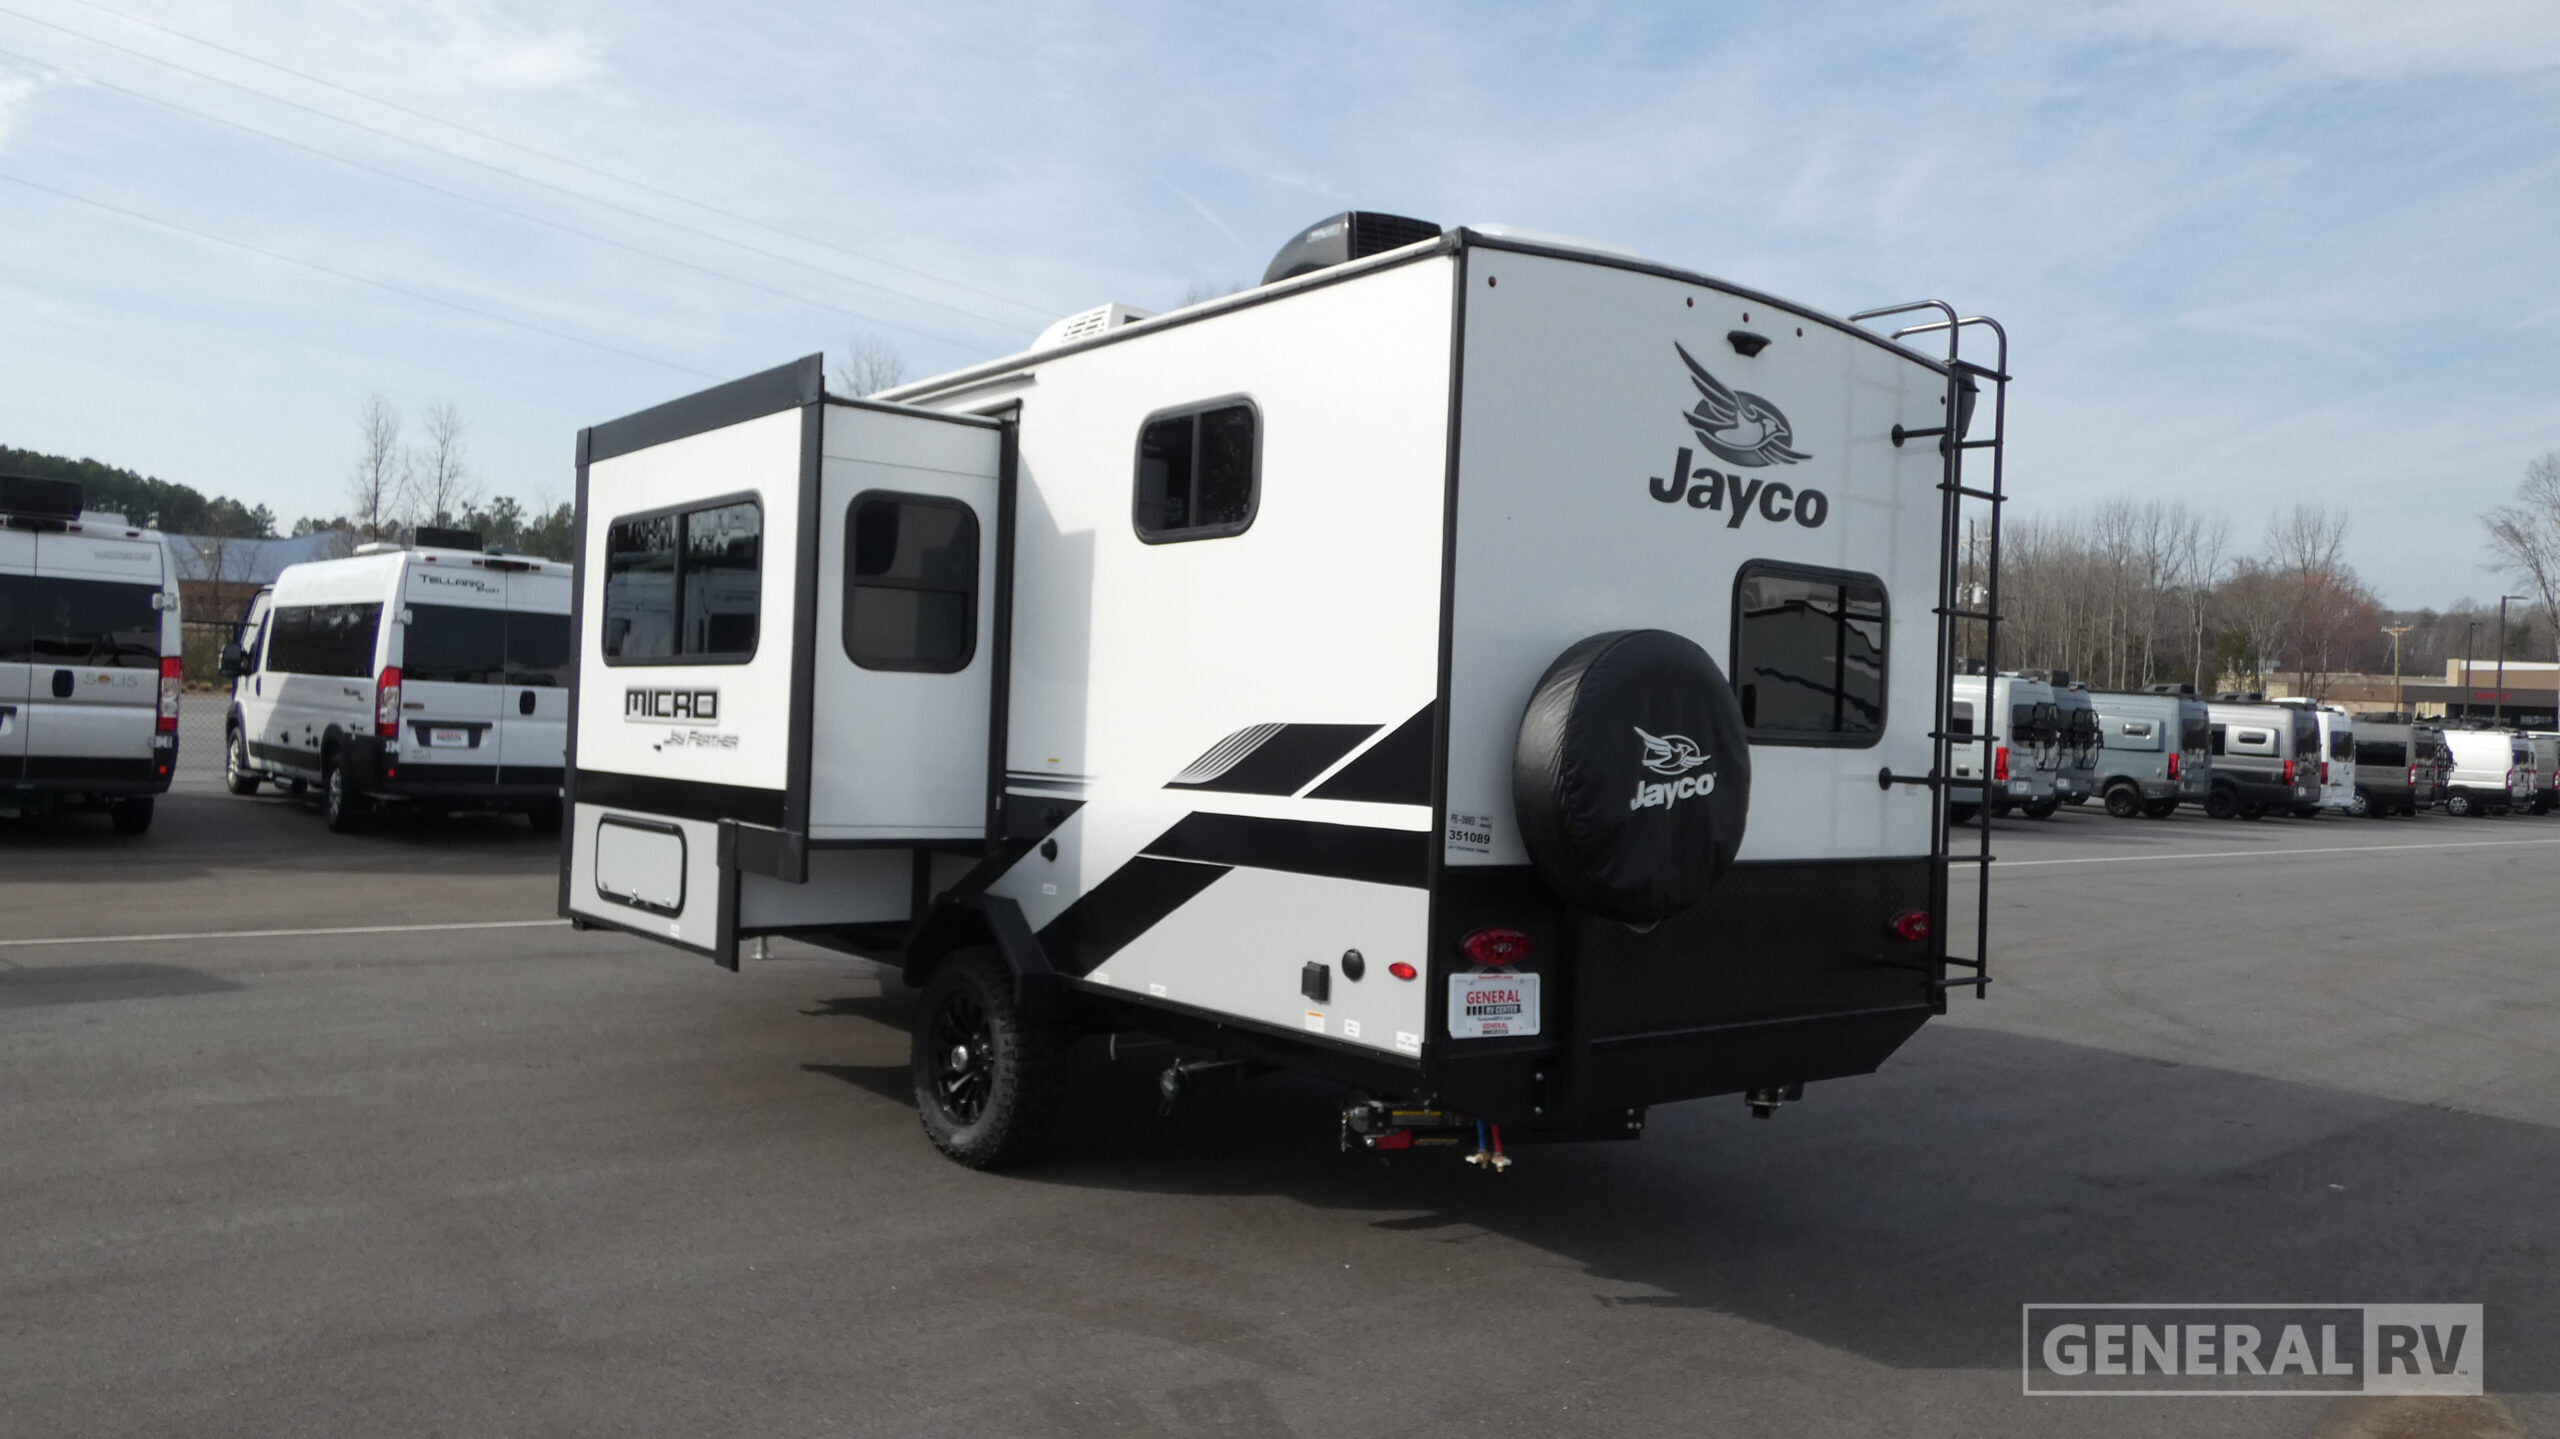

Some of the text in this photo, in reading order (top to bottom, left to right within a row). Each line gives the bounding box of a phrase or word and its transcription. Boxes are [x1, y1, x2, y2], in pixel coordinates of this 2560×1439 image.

[1649, 446, 1829, 530] Jayco
[625, 689, 718, 719] MICRO
[1630, 772, 1715, 811] Jayco
[1448, 829, 1491, 845] 351089
[1466, 989, 1521, 1005] GENERAL
